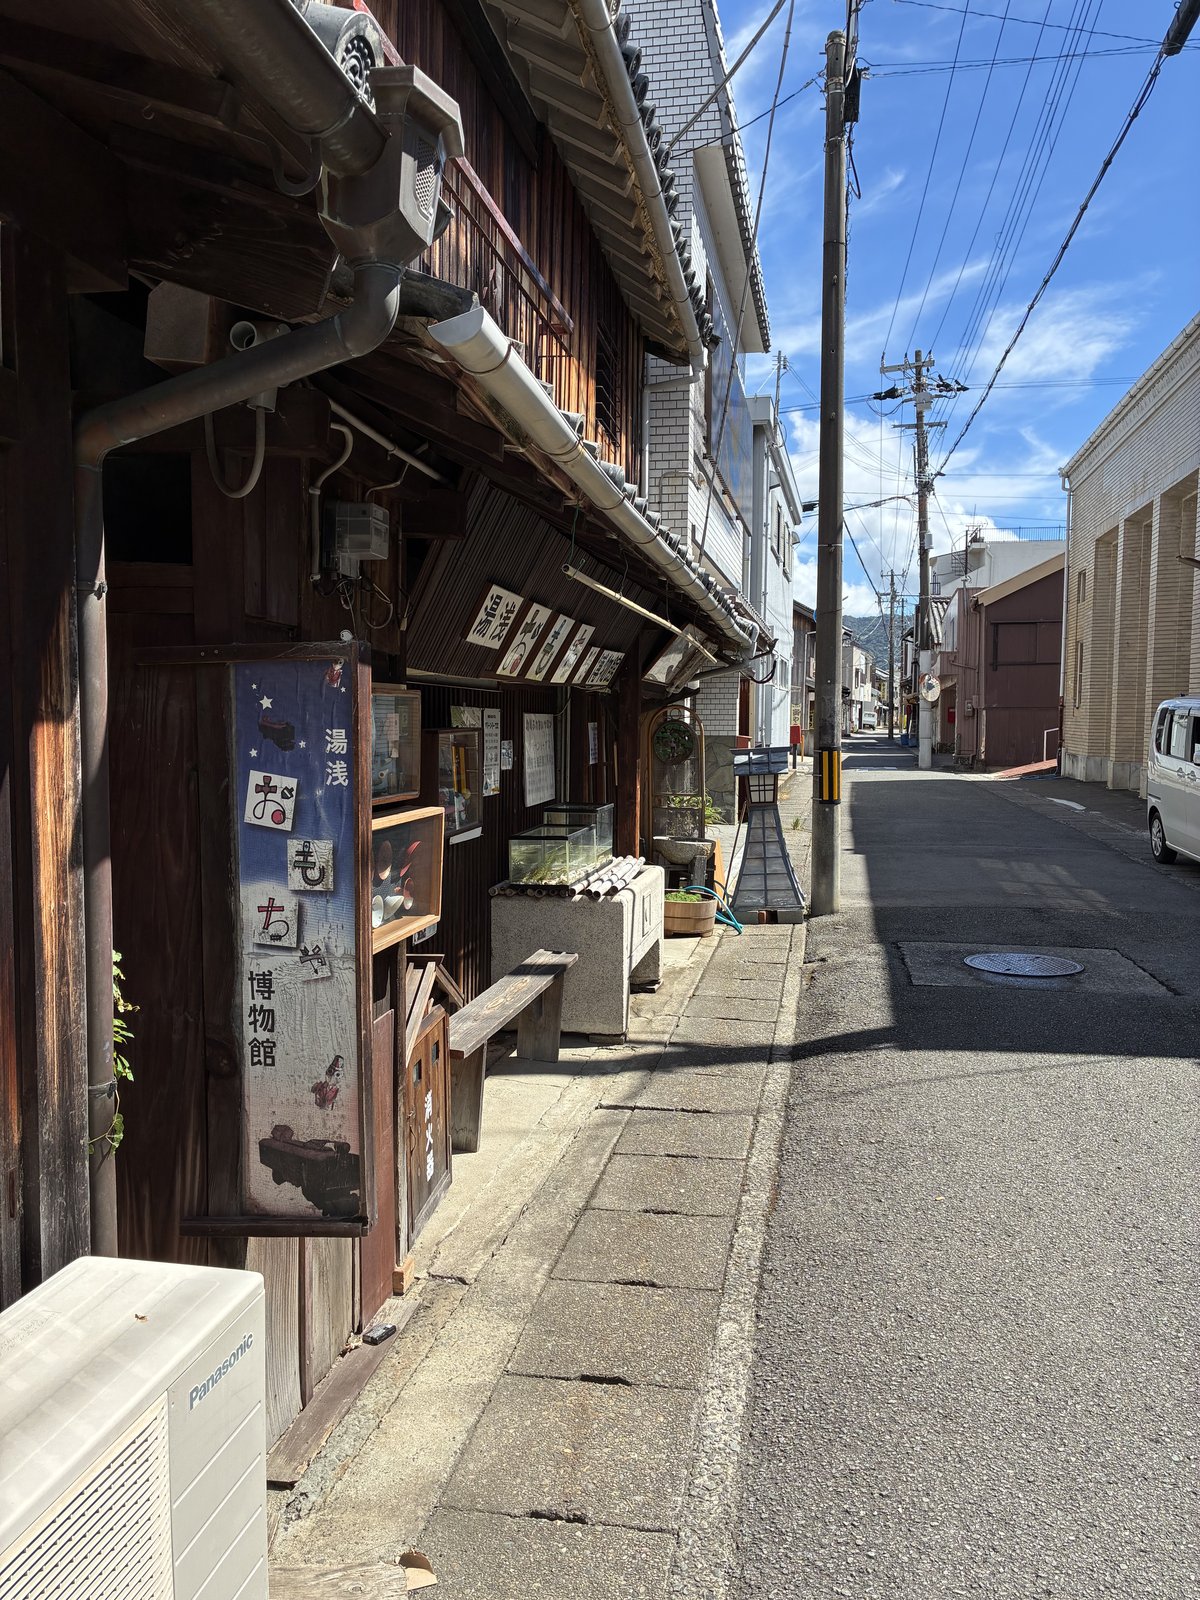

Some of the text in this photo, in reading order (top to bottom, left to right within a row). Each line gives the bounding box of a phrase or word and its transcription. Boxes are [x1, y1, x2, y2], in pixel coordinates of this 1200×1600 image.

[472, 593, 516, 642] 湯浅
[324, 728, 349, 787] 湯浅
[248, 970, 277, 1067] 博物館
[189, 1333, 253, 1411] Panasonic
